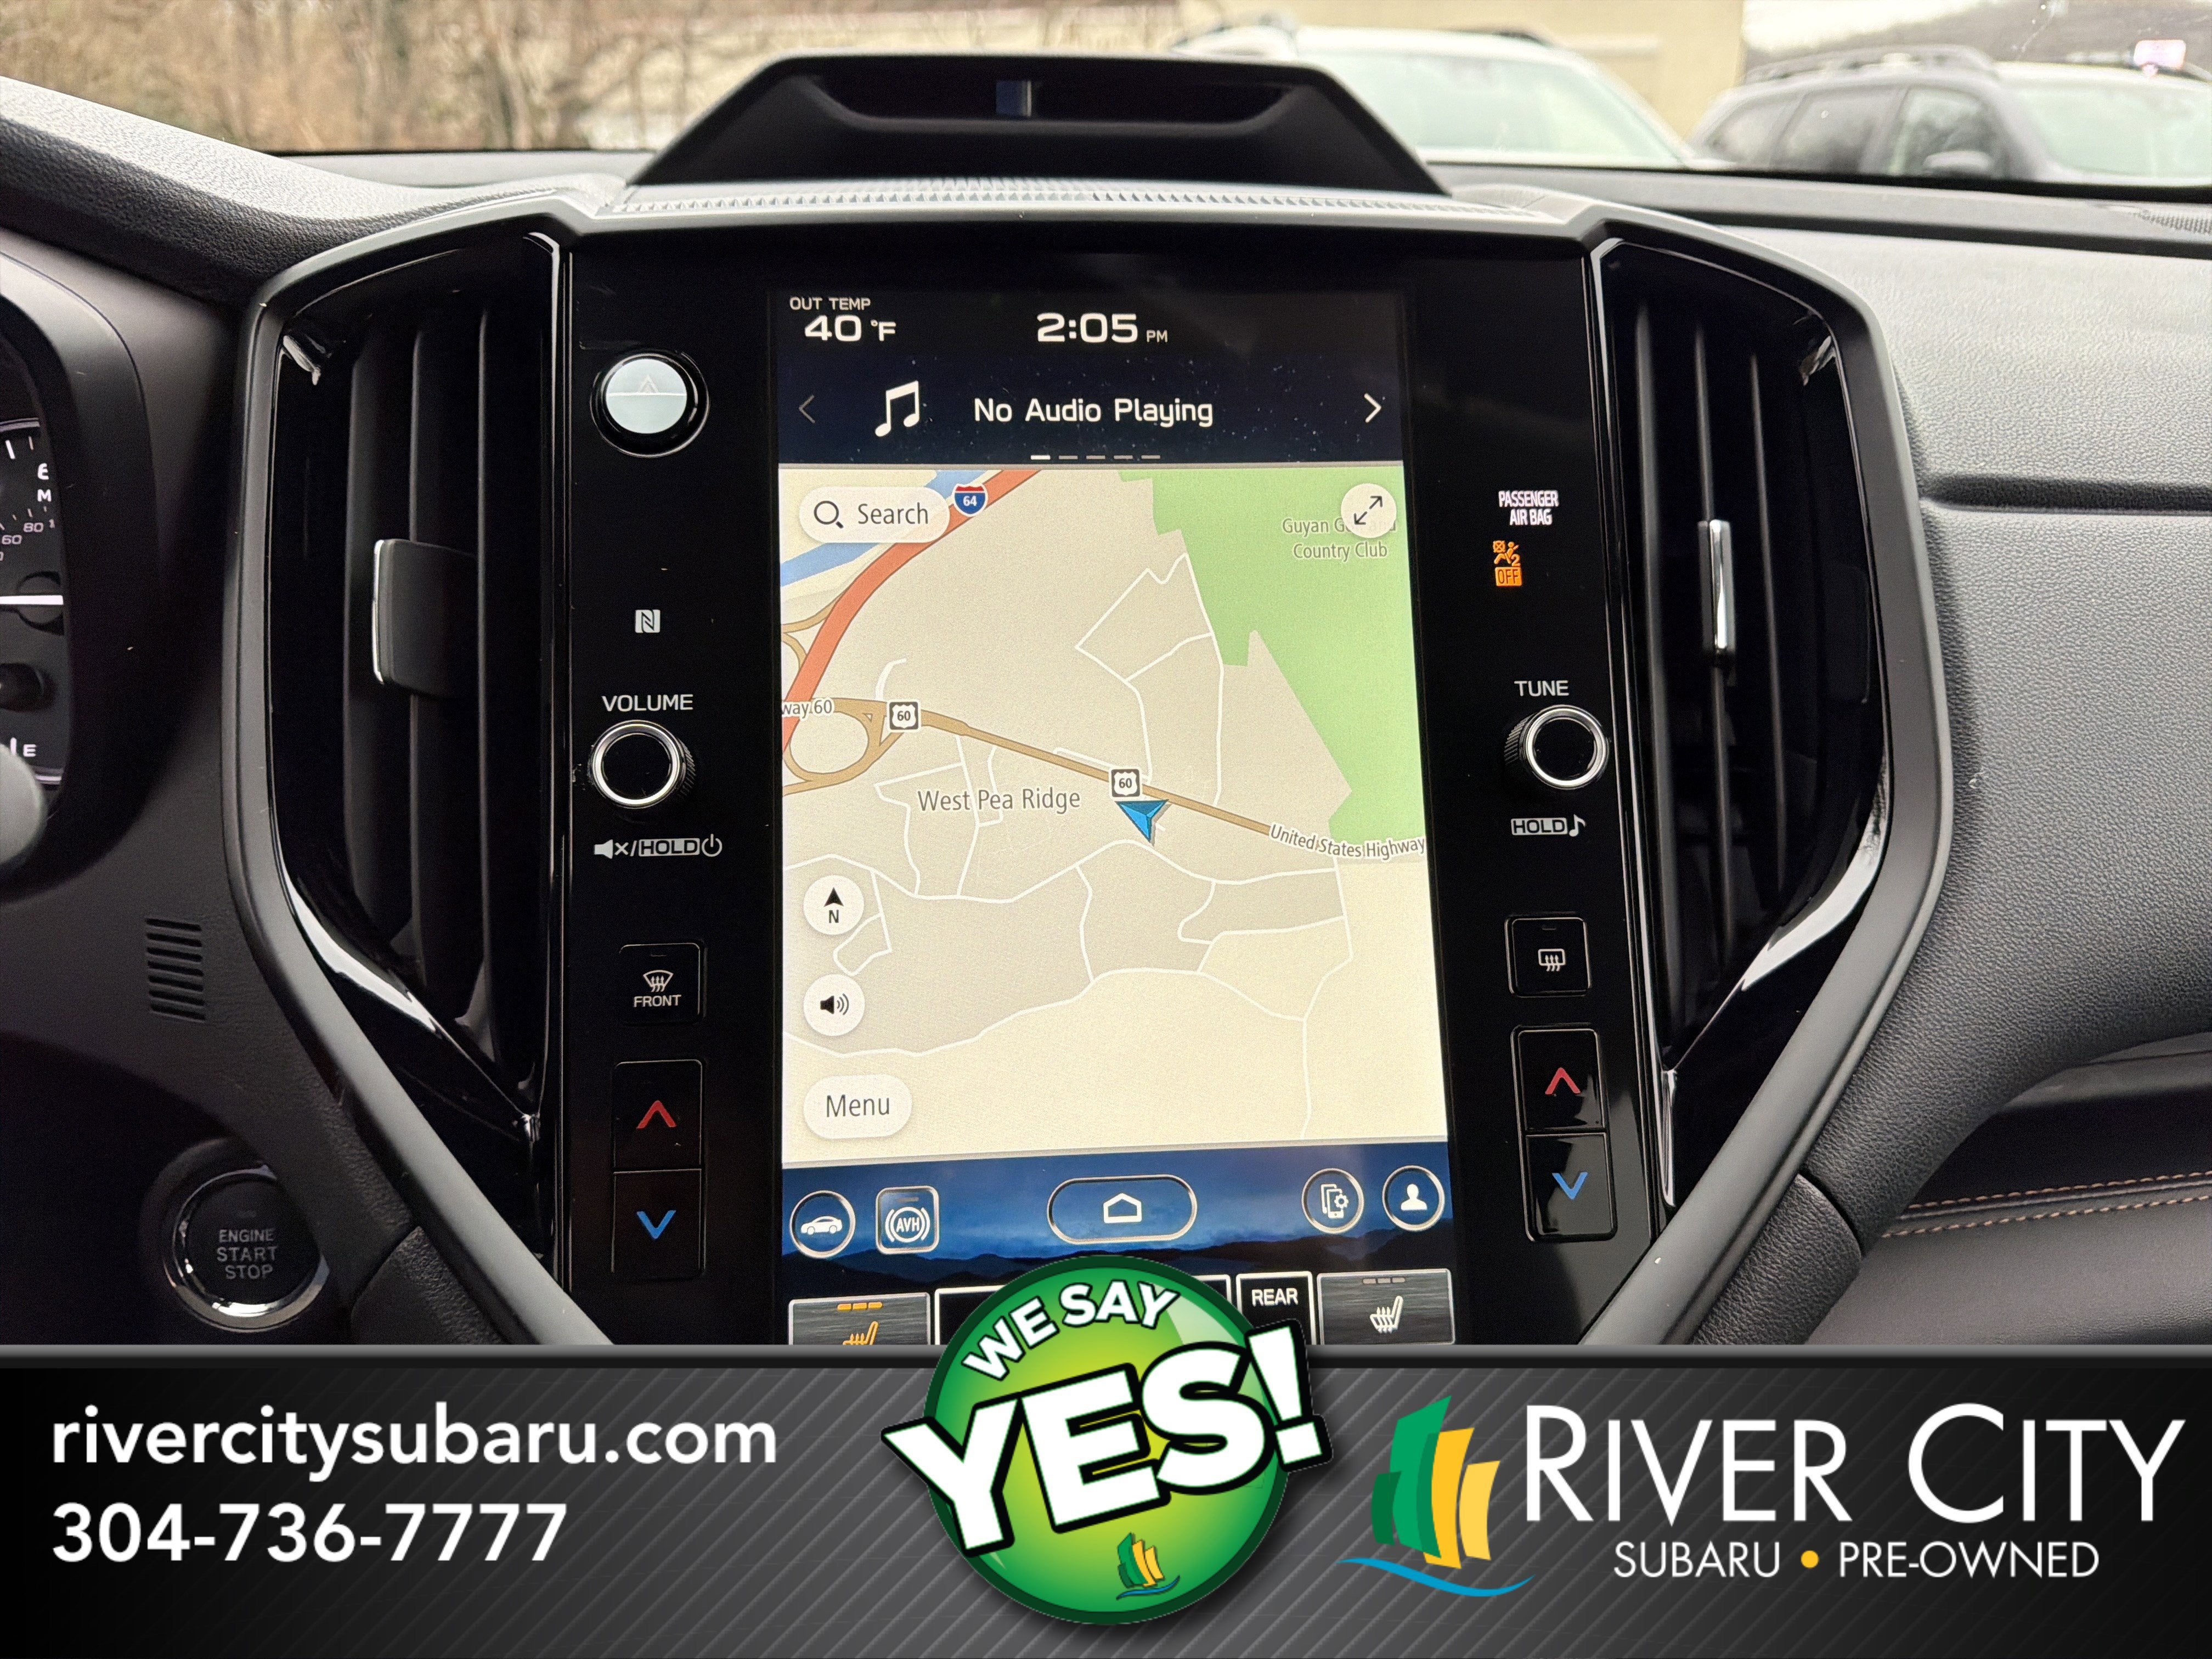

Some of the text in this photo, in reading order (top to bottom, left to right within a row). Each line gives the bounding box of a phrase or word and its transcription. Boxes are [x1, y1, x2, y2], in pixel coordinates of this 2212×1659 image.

[789, 296, 871, 311] OUT TEMP
[1037, 313, 1168, 343] 2:05 PM
[974, 398, 1213, 428] No Audio Playing
[963, 495, 978, 507] 64
[1498, 490, 1559, 507] PASSENGER
[858, 502, 928, 524] Search
[1509, 508, 1553, 526] AIR BAG
[23, 522, 44, 533] 80
[1283, 517, 1329, 538] Guyan
[1, 534, 22, 545] 60
[1293, 540, 1387, 562] Country Club
[1498, 568, 1520, 584] OFF
[1514, 680, 1570, 697] TUNE
[601, 694, 693, 712] VOLUME
[814, 699, 832, 714] 60
[897, 710, 911, 721] 60
[22, 744, 37, 757] E
[1119, 777, 1132, 789] 60
[918, 788, 1081, 814] West Pea Ridge
[1513, 819, 1565, 833] HOLD
[1271, 825, 1426, 860] United States Highway
[828, 909, 839, 924] N
[634, 994, 682, 1008] FRONT
[826, 1094, 889, 1118] Menu
[896, 1217, 921, 1234] AVH
[219, 1229, 274, 1243] ENGINE
[217, 1246, 278, 1262] START
[225, 1265, 273, 1279] STOP
[1251, 1288, 1299, 1306] REAR
